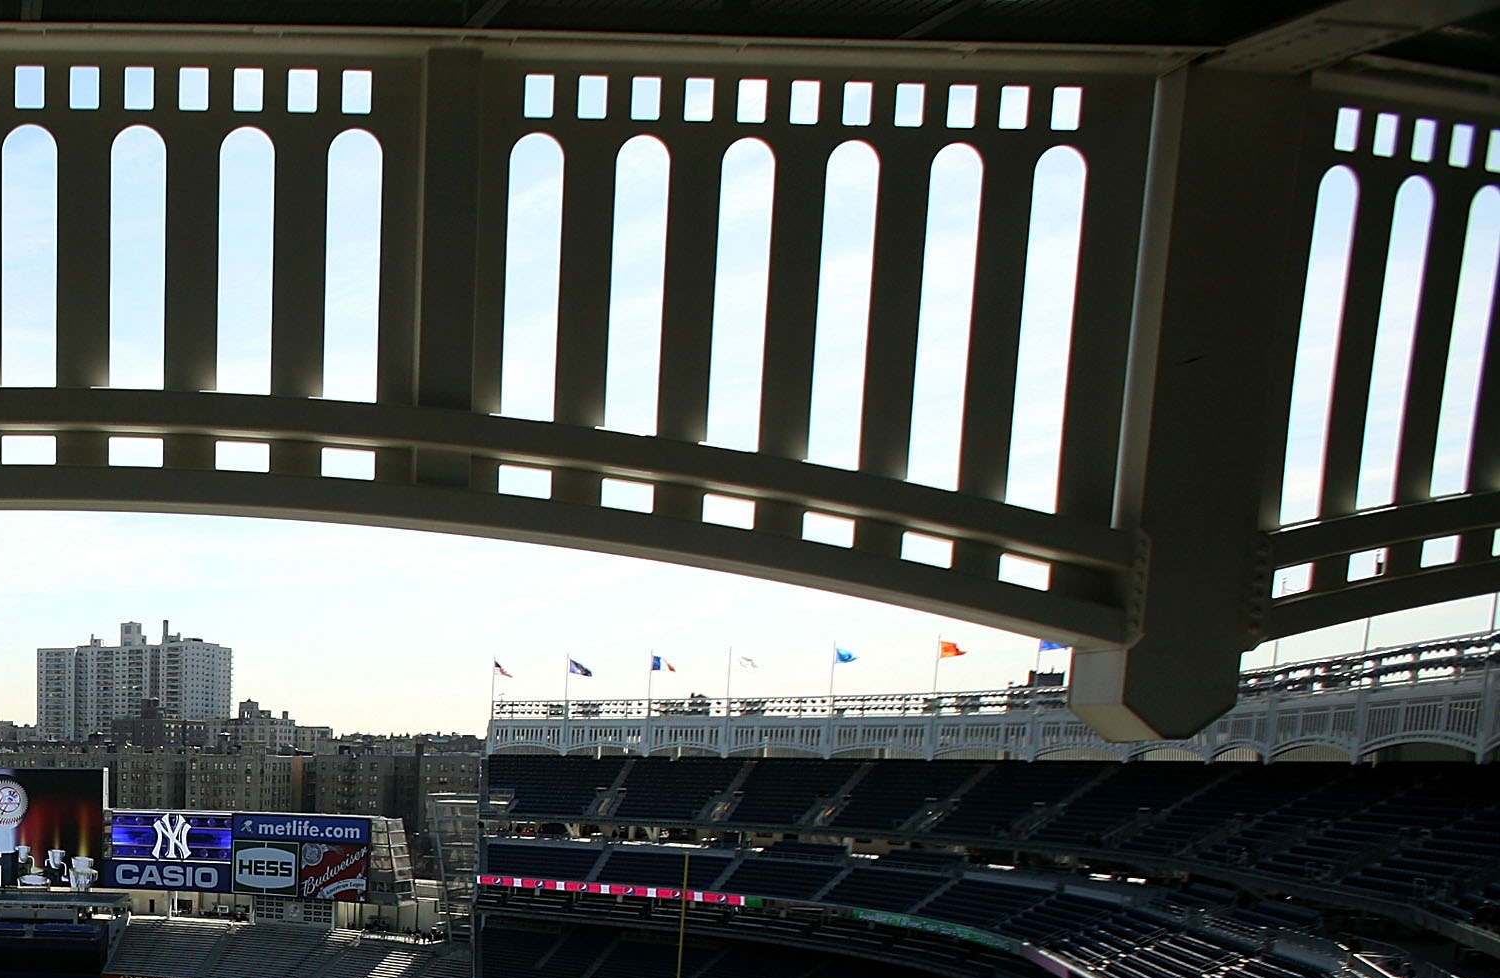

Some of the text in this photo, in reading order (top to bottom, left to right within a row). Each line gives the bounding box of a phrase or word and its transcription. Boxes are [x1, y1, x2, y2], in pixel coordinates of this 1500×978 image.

[257, 820, 361, 840] metlife.com
[115, 863, 219, 889] CASIO
[238, 859, 293, 878] HESS
[301, 846, 368, 897] Budweiser
